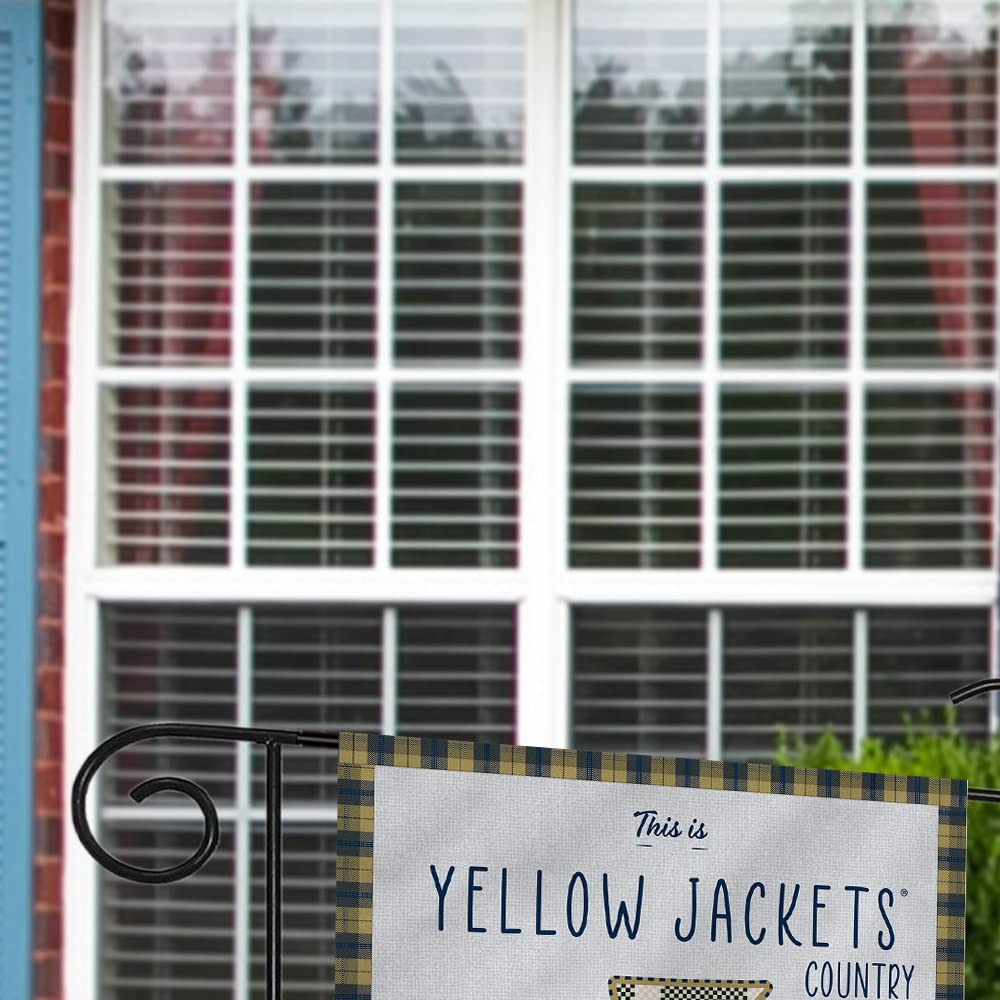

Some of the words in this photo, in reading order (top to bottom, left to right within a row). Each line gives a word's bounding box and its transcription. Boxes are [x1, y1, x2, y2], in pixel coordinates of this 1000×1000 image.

[634, 810, 682, 838] This
[688, 818, 708, 841] is
[430, 865, 644, 940] YELLOW
[804, 960, 915, 1000] COUNTRY
